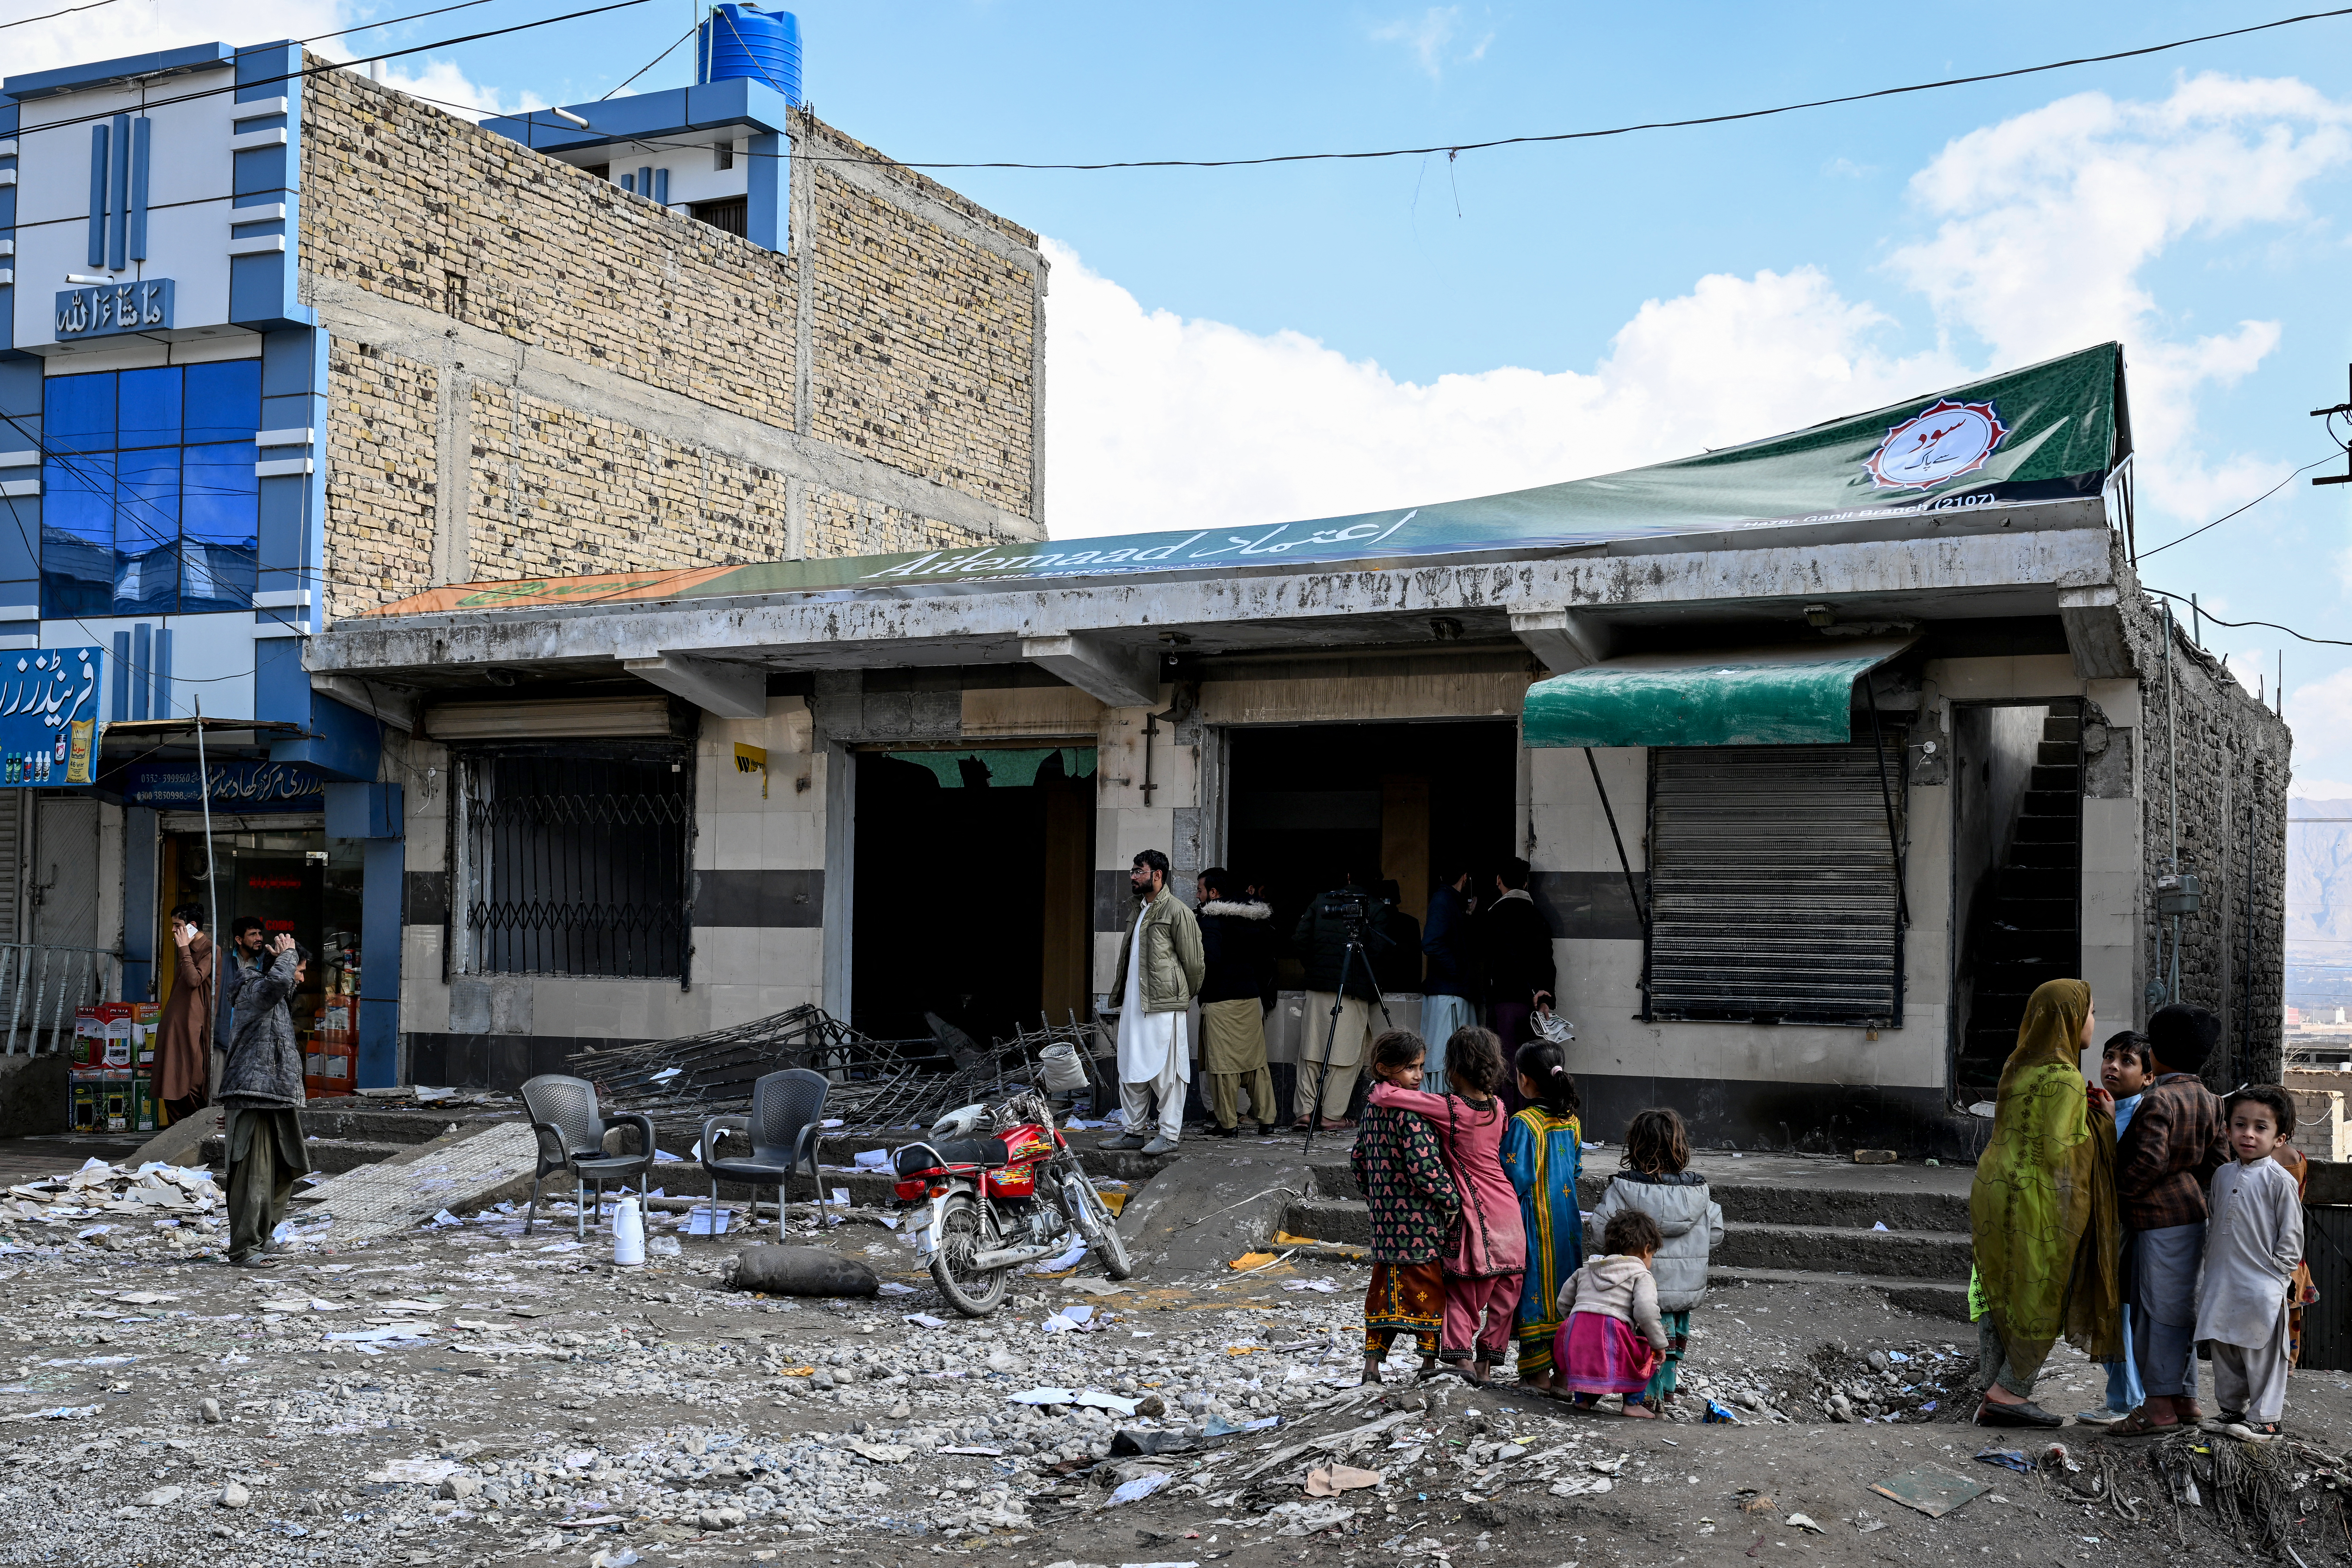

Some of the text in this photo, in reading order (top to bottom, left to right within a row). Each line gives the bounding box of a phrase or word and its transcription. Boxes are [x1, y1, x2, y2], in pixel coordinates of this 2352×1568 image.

[1907, 419, 1966, 454] سود
[1904, 448, 1935, 471] پاک
[1744, 493, 1995, 528] Hazar Ganji Branch (2107)
[1189, 509, 1418, 558] اعتماد
[859, 532, 1210, 579] Aitemaad
[956, 567, 1128, 582] ISLAMIC BANKING
[536, 580, 658, 596] NBP
[78, 1072, 97, 1080] Orange
[107, 1071, 129, 1080] Orange
